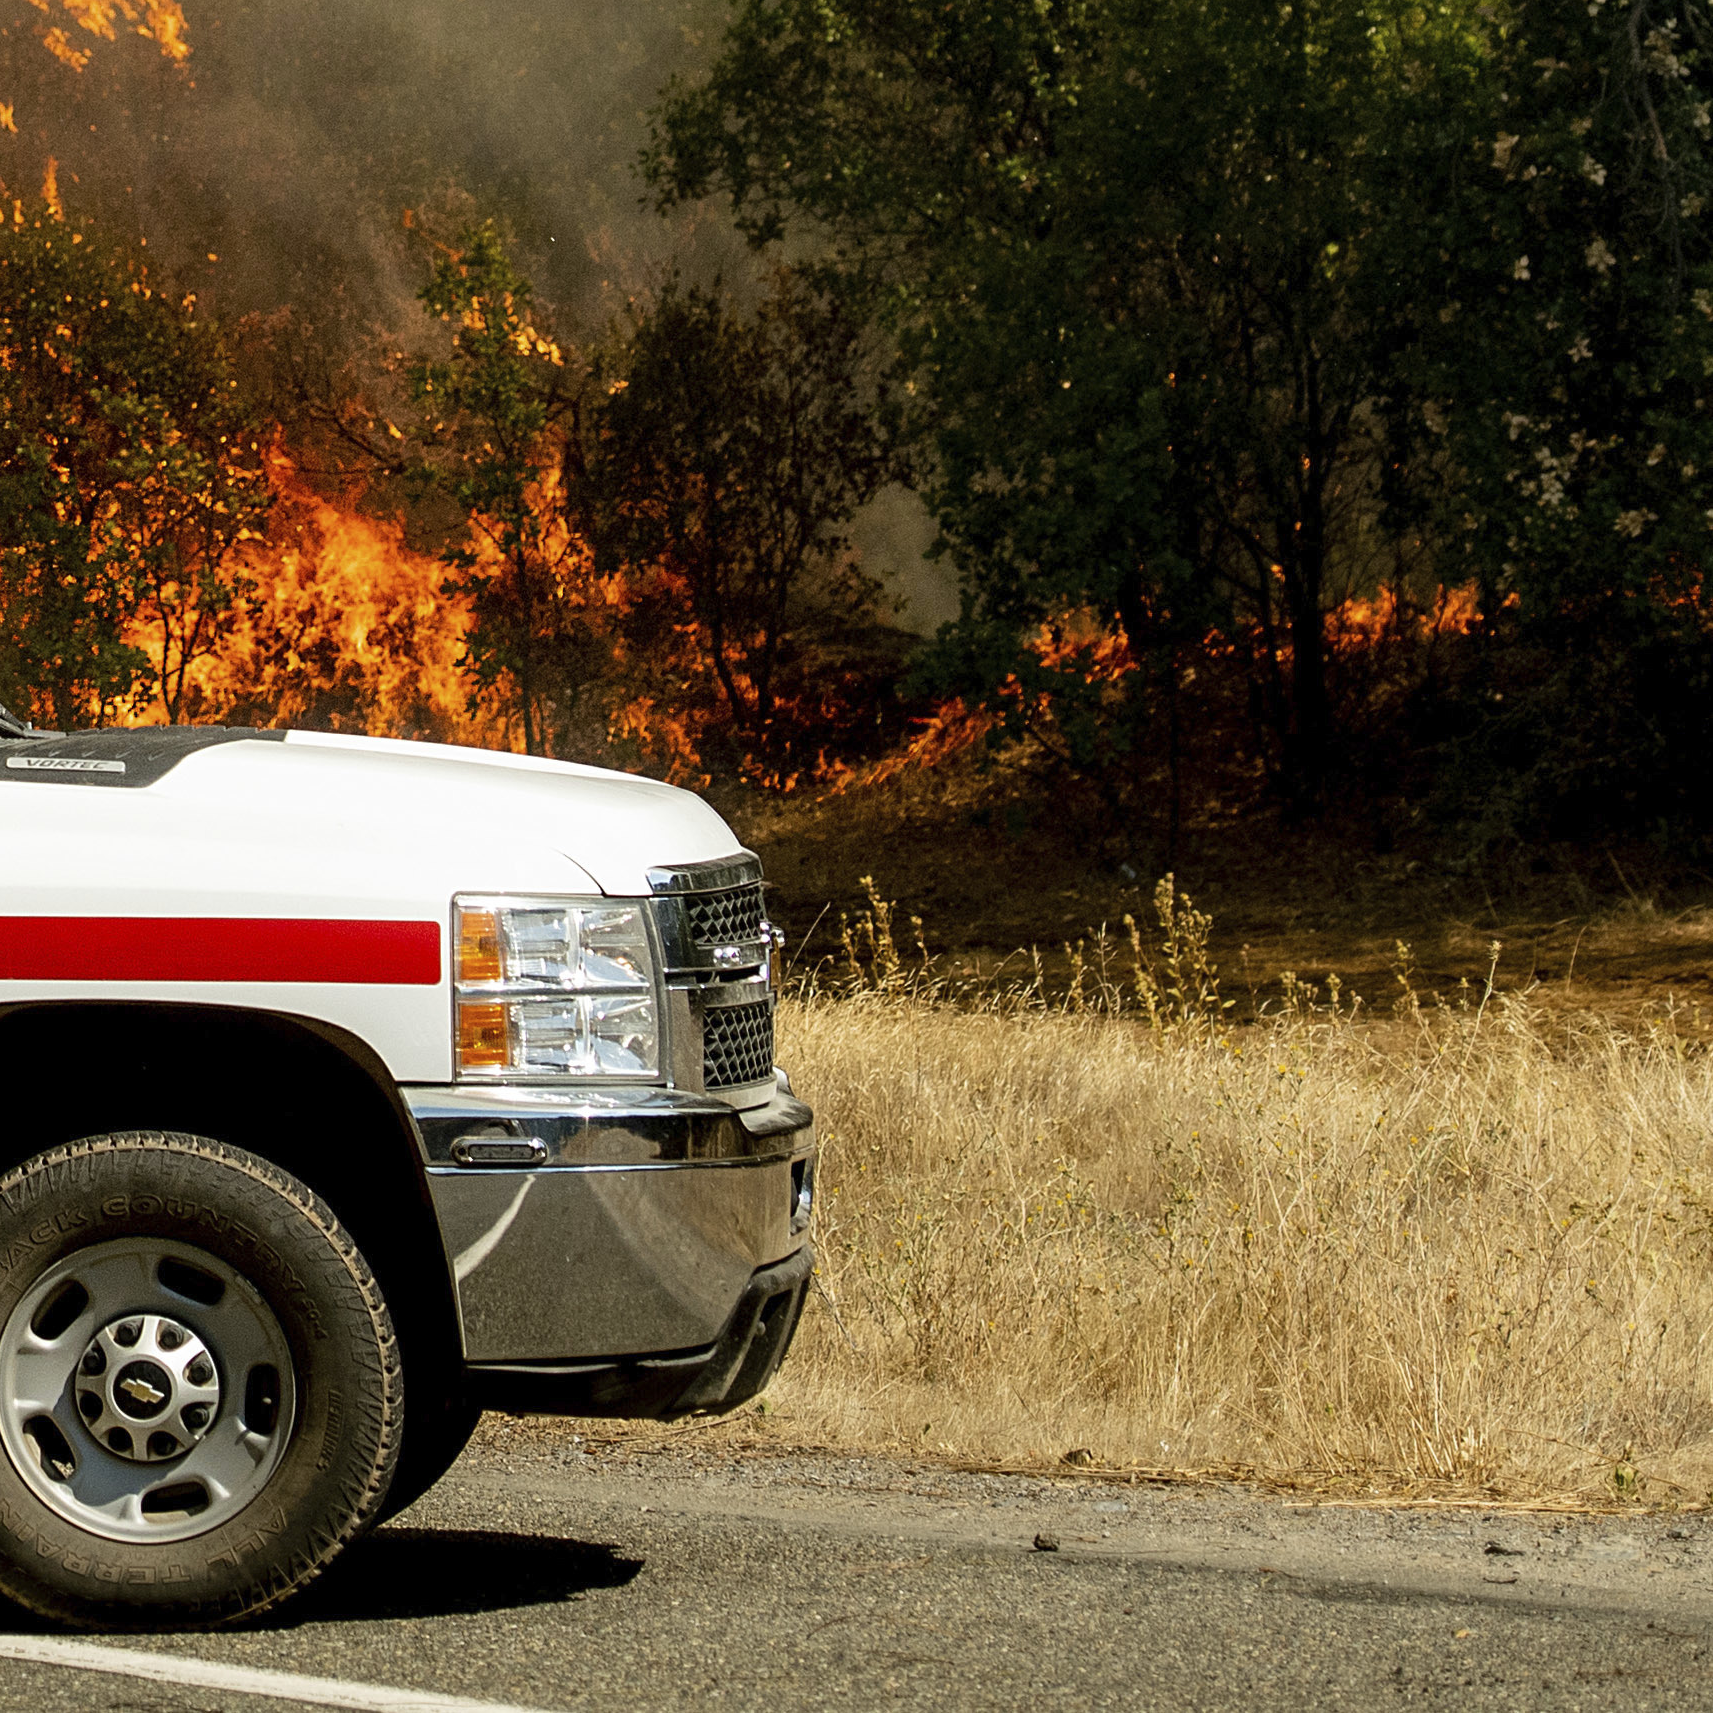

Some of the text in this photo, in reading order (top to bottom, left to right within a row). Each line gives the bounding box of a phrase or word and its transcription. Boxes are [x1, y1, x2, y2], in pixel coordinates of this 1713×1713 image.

[26, 759, 108, 770] VORTEC
[102, 1195, 306, 1295] COUNTRY
[205, 1508, 289, 1568] ALL
